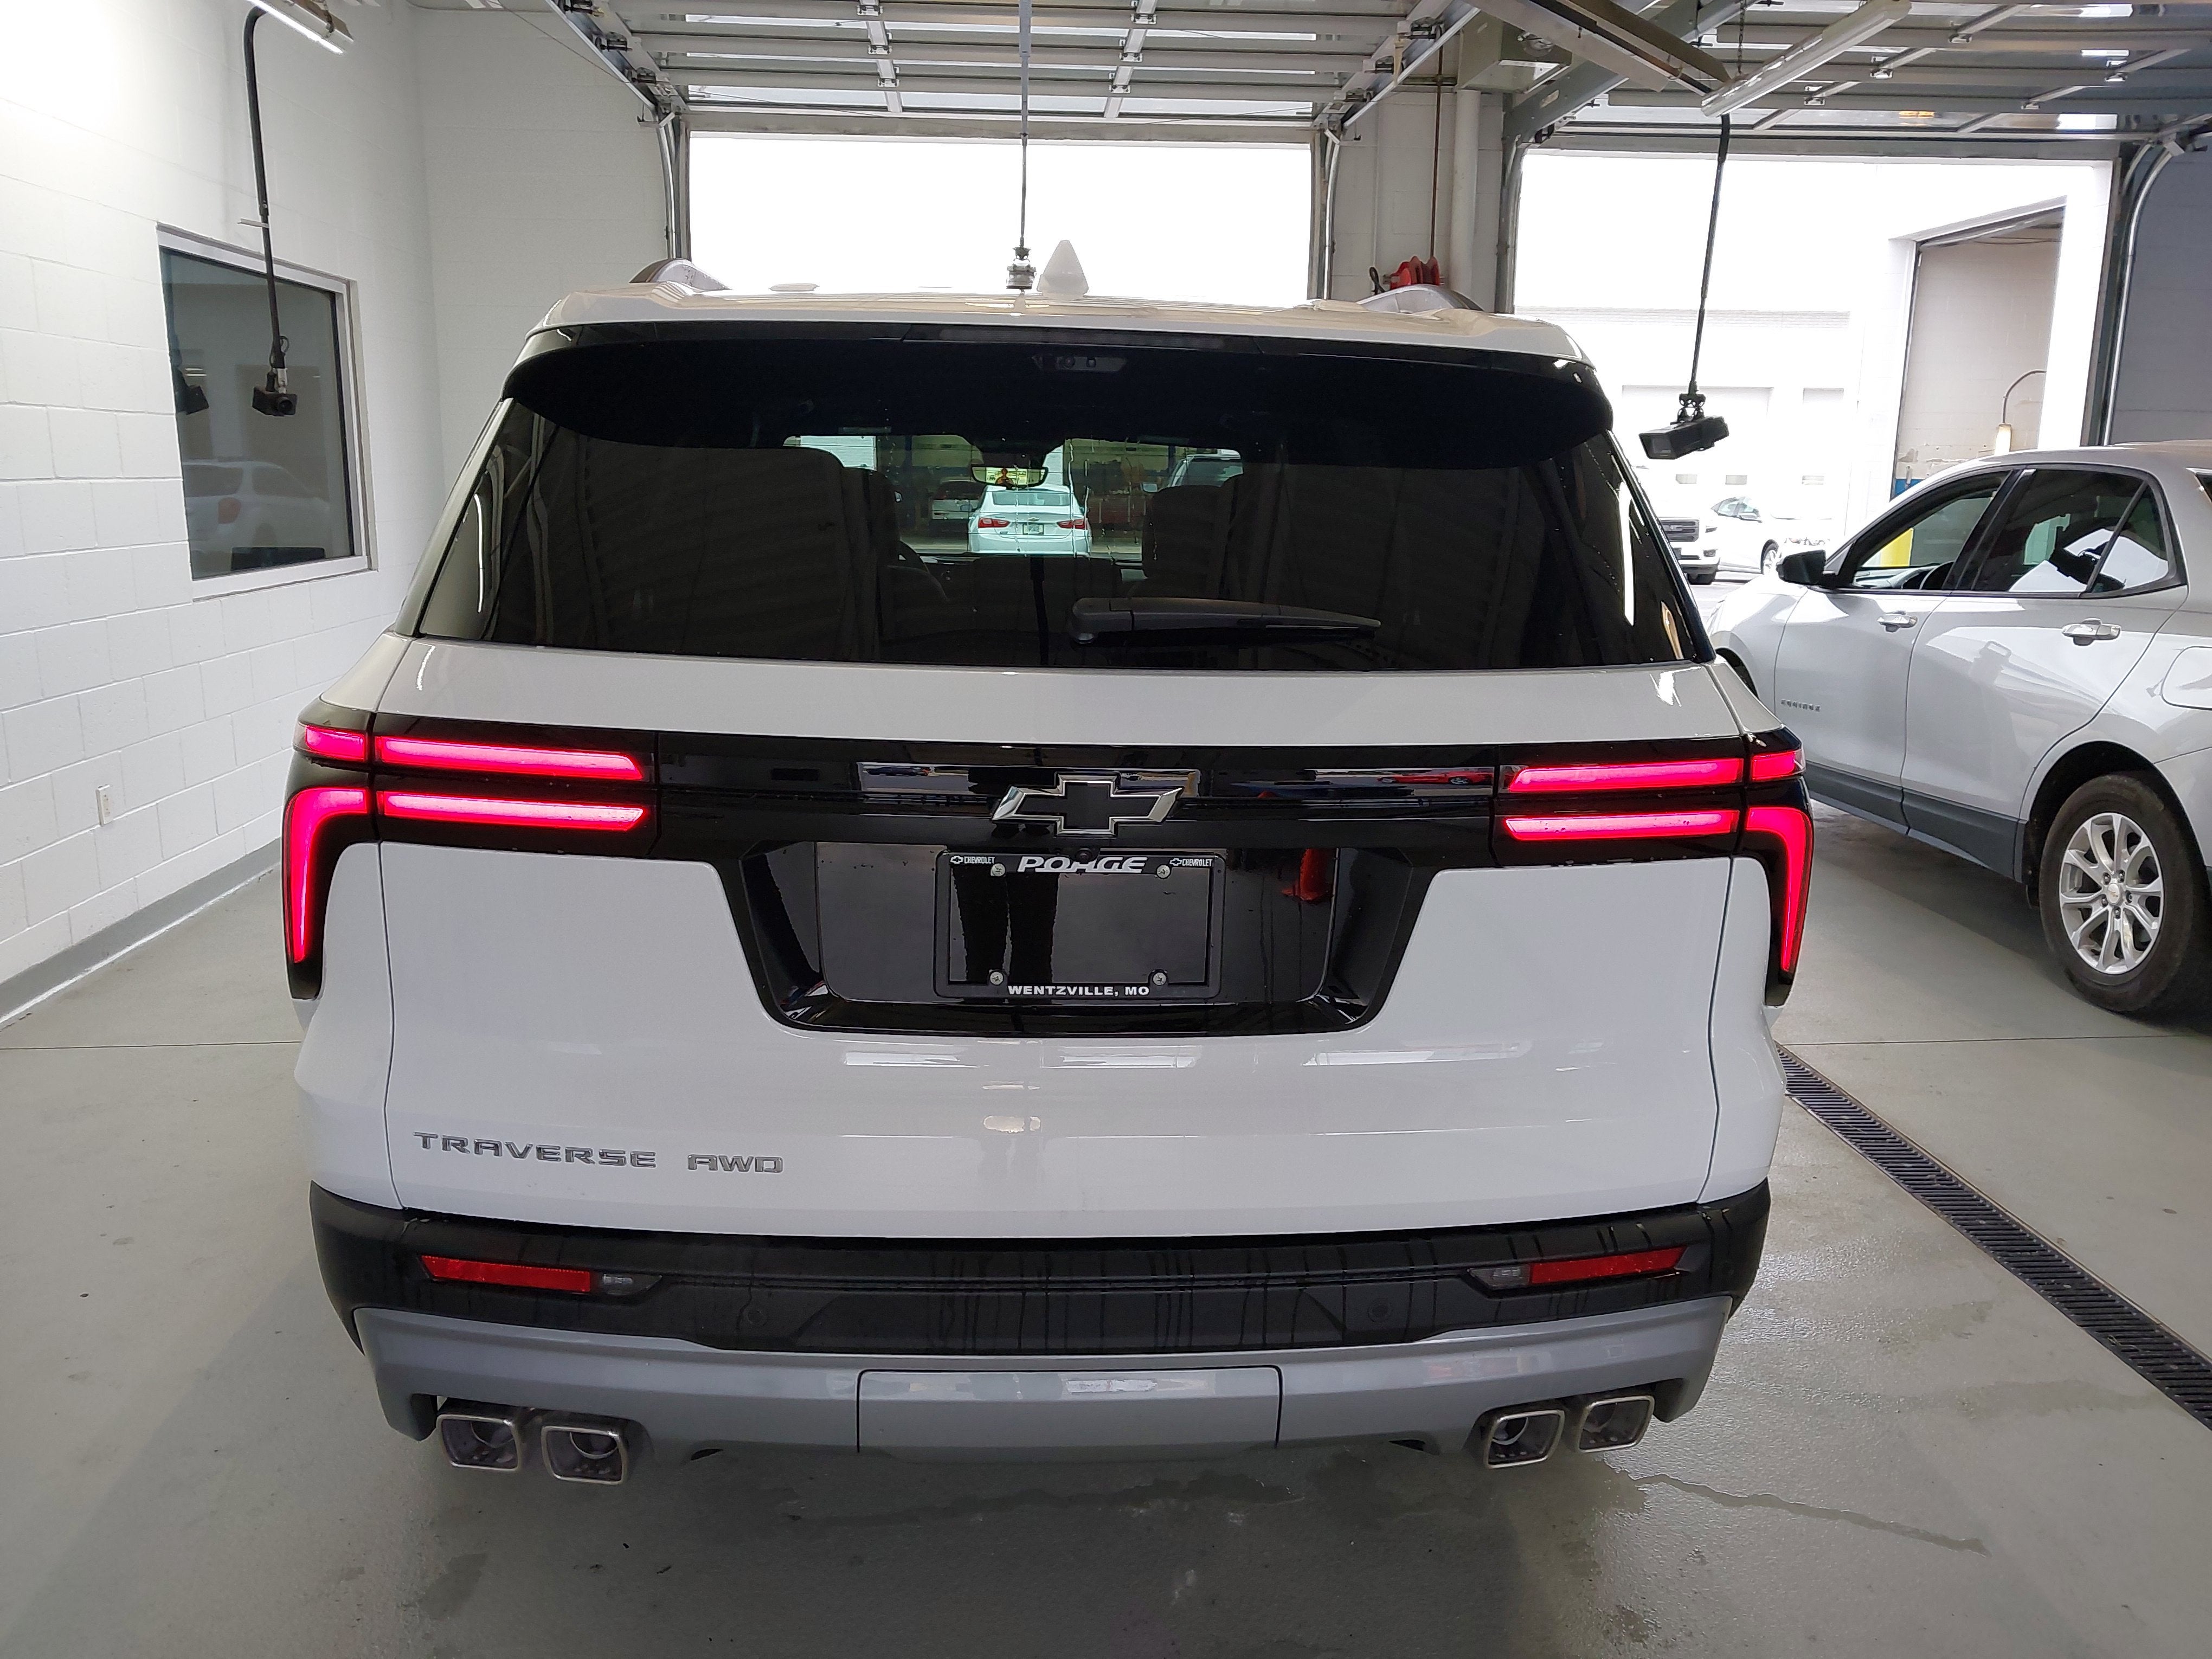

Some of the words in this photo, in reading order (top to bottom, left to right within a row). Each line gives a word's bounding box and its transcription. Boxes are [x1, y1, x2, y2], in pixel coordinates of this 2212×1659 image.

[964, 856, 995, 864] CHEVROLET
[1182, 858, 1213, 867] CHEVROLET
[1007, 985, 1118, 997] WENTZVILLE,
[1124, 986, 1149, 995] MO
[414, 1131, 657, 1168] TRAVERSE
[687, 1154, 784, 1173] AWD
